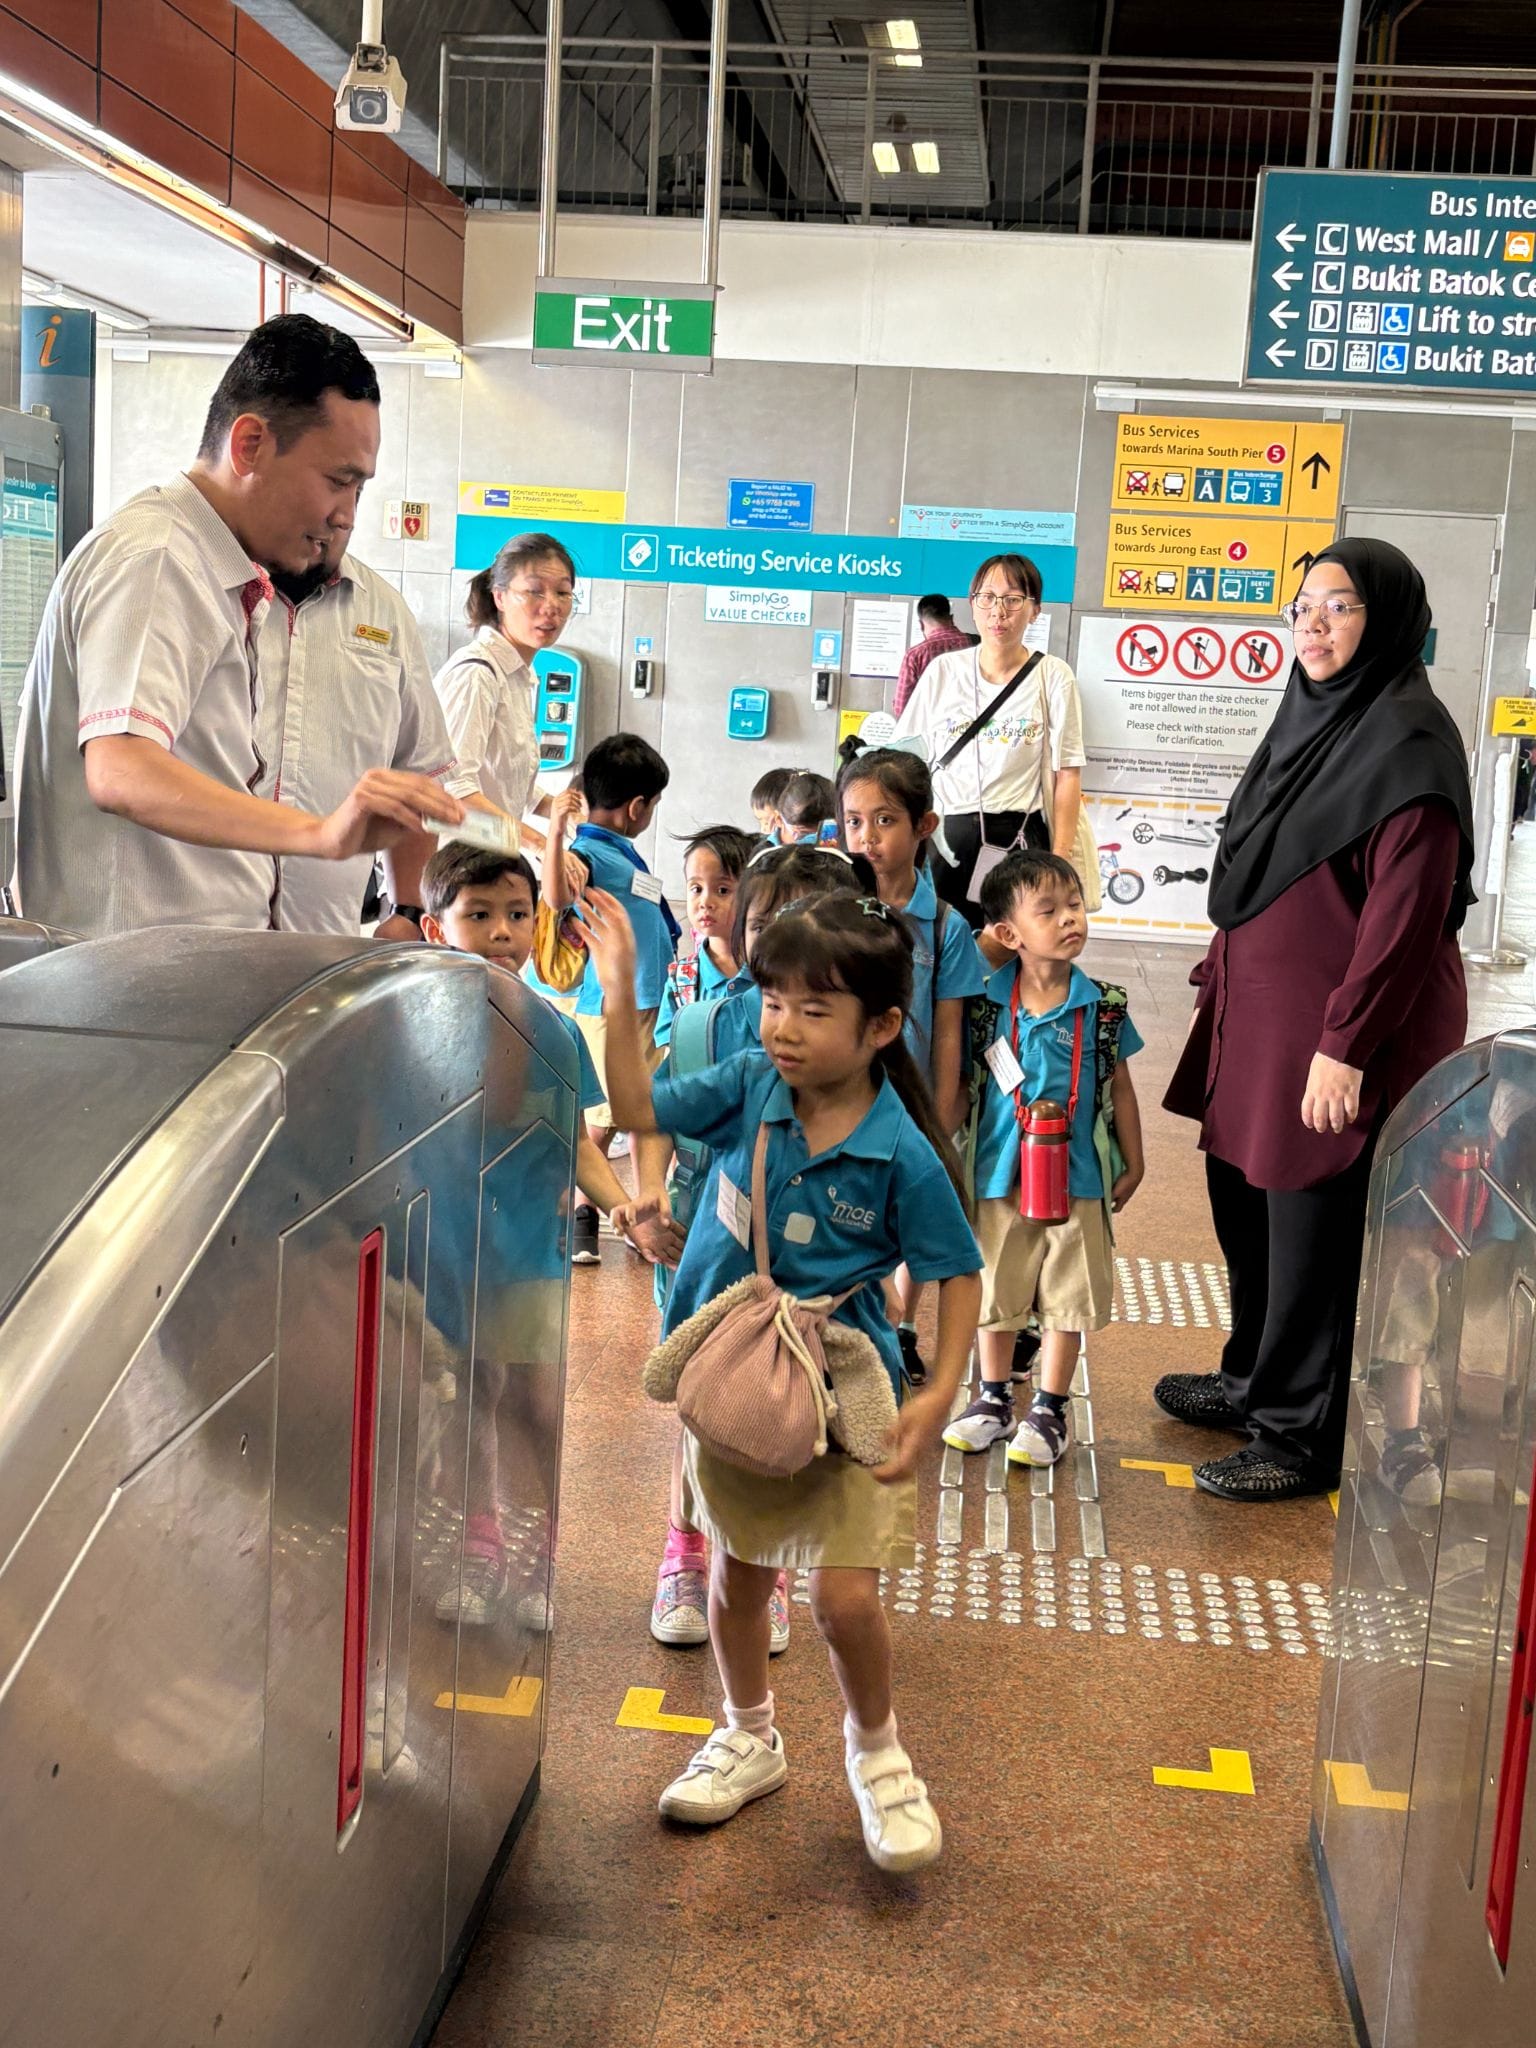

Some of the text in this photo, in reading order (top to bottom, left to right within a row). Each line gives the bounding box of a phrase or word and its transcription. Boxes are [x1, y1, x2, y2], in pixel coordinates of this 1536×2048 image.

[1430, 191, 1477, 217] Bus
[1322, 226, 1342, 252] C
[1355, 226, 1417, 254] West
[1423, 229, 1480, 256] Mall
[1318, 265, 1338, 291] C
[1351, 265, 1422, 293] Bukit
[1429, 269, 1505, 297] Batok
[572, 296, 673, 352] Exit
[1315, 303, 1536, 337] D Lift to str
[1311, 342, 1536, 376] D Bukit Bat
[1122, 423, 1200, 439] Bus Services
[1122, 443, 1281, 460] towards Marina South Pier 5
[1198, 479, 1215, 500] A
[1262, 490, 1272, 503] 3
[405, 504, 421, 514] AED
[1001, 521, 1035, 531] SimplyGo
[1115, 523, 1192, 539] Bus Services
[1114, 542, 1242, 558] towards Jurong East 4
[666, 545, 902, 578] Ticketing Service Kiosks
[1190, 577, 1207, 598] A
[1255, 588, 1264, 600] 5
[729, 590, 790, 608] SimplyGo
[710, 607, 807, 623] VALUE CHECKER
[1121, 688, 1269, 706] Items bigger than the size checker
[1129, 703, 1258, 718] are not allowed in the station.
[1126, 719, 1258, 736] Please check with station staff
[1156, 733, 1225, 747] for clarification.
